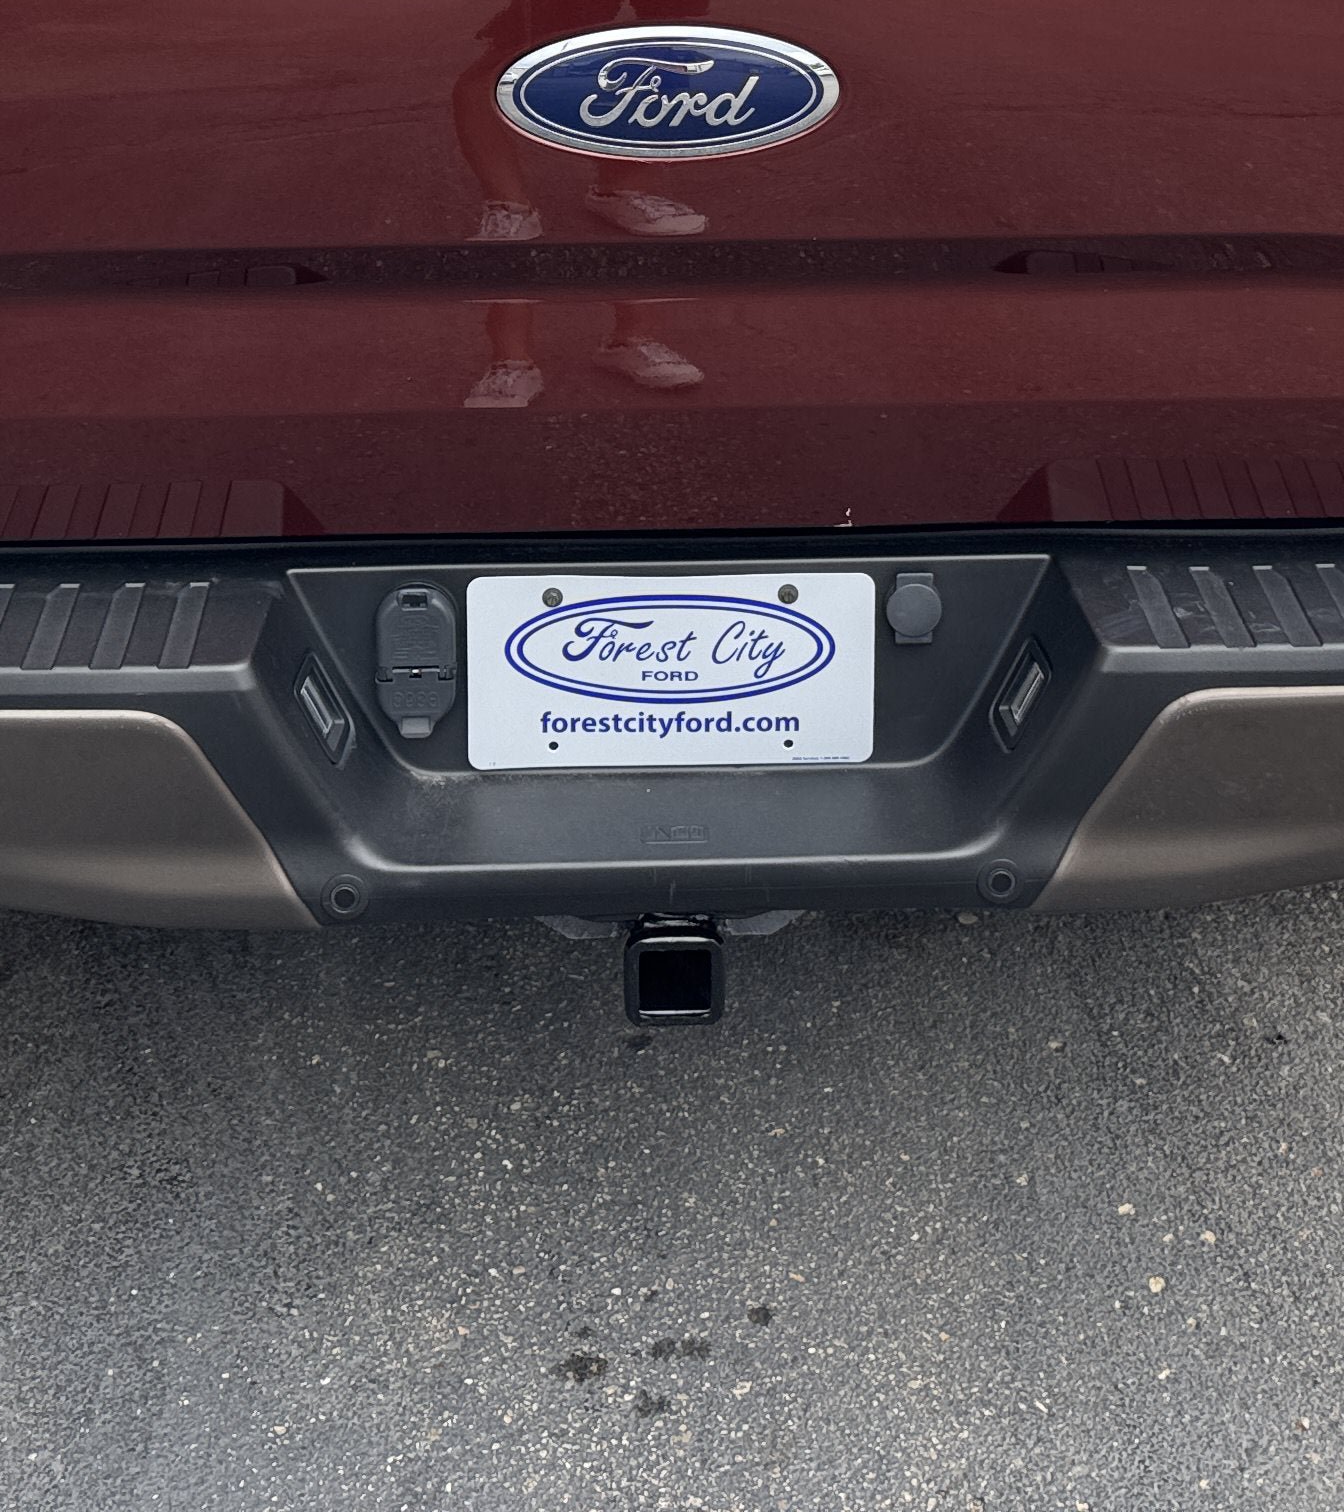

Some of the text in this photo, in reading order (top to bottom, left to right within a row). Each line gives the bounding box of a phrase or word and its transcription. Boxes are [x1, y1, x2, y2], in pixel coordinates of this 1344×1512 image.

[578, 56, 760, 128] Ford
[561, 617, 786, 679] Forest City
[641, 670, 699, 682] FORD
[540, 711, 801, 739] forestcityford.com
